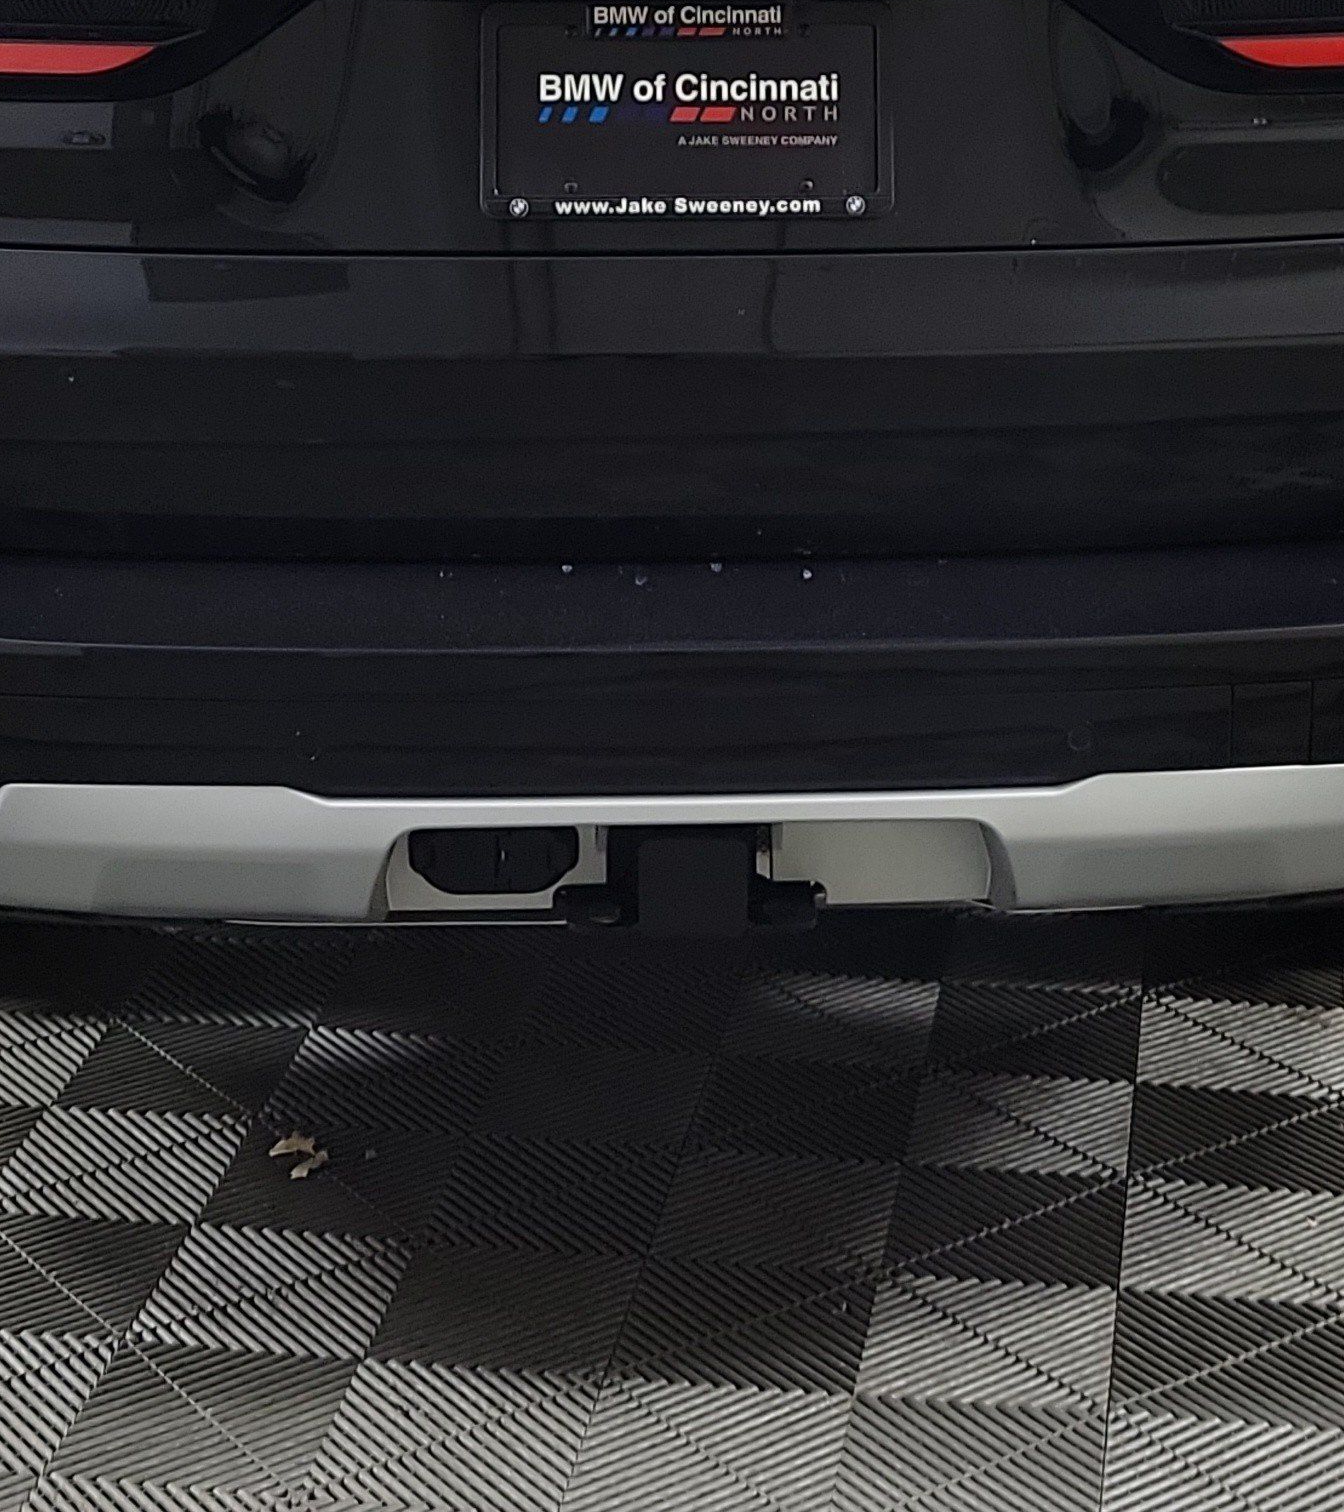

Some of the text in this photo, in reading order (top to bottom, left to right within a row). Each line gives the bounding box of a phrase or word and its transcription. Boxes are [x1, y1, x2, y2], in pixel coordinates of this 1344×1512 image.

[593, 4, 783, 25] BMW of Cincinnati
[731, 26, 784, 37] NORTH
[538, 72, 840, 104] BMW of Cincinnati
[739, 106, 840, 124] NORTH
[677, 135, 839, 148] A JAKE SWEENEY COMPANY
[673, 197, 822, 218] Sweeney.com
